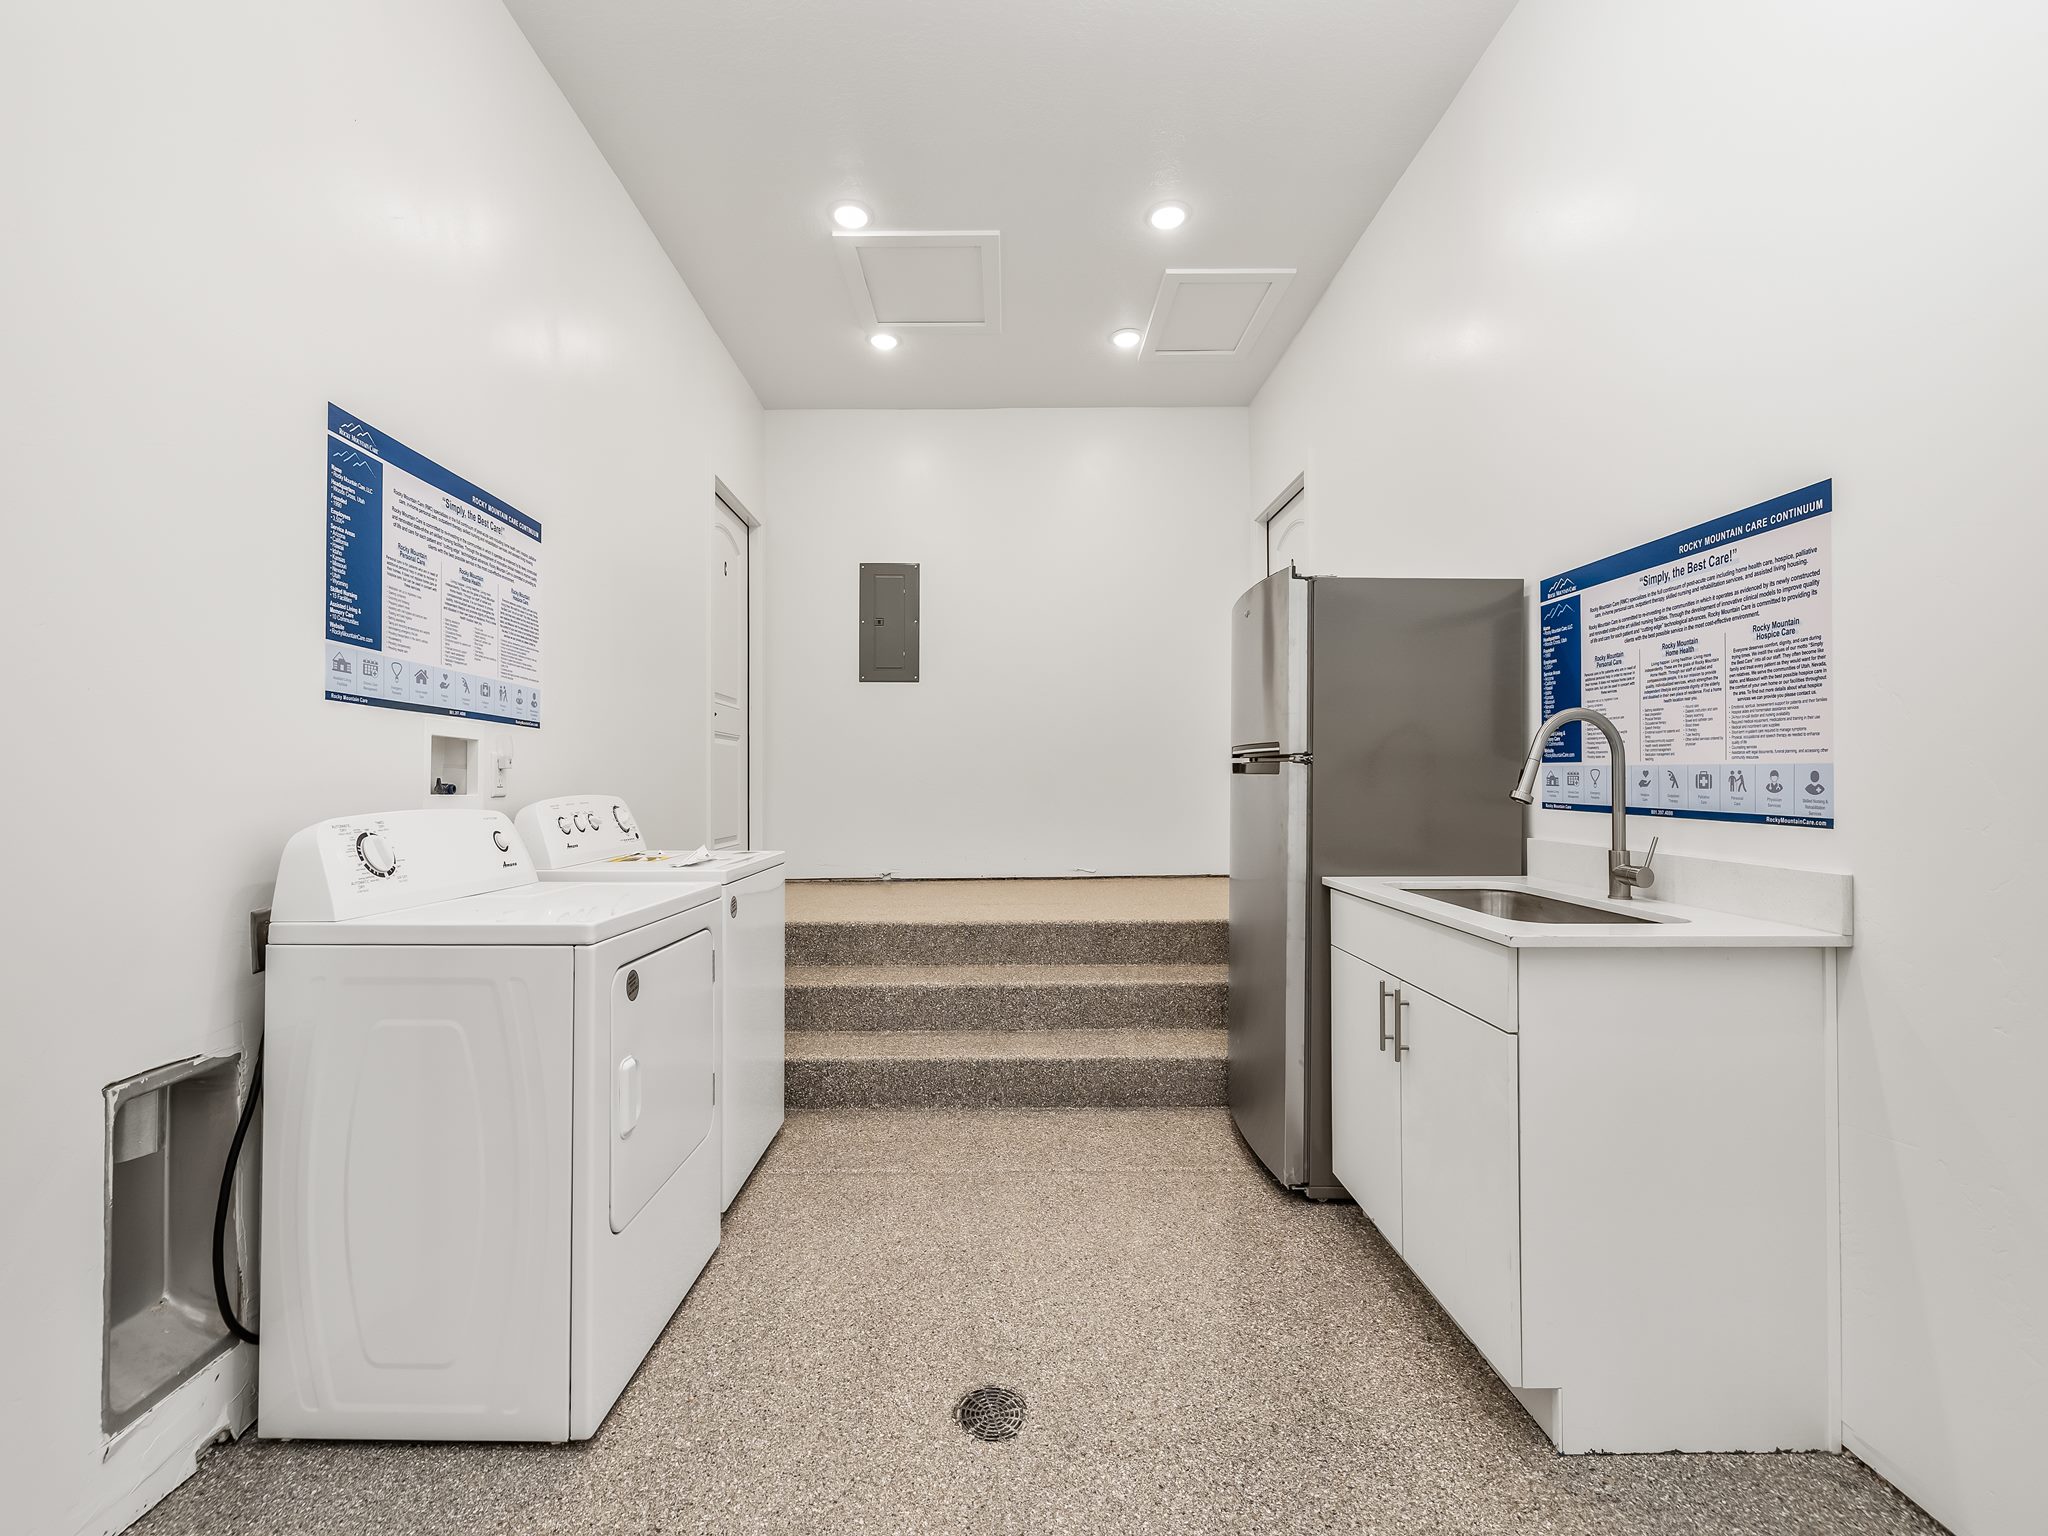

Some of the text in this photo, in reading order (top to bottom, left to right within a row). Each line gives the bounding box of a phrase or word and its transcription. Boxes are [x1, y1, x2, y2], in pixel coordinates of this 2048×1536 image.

[471, 495, 487, 510] ROCKY
[467, 509, 476, 522] the
[477, 514, 489, 528] Best
[1678, 498, 1823, 554] ROCKY MOUNTAIN CARE CONTINUUM
[1672, 565, 1685, 578] the
[1686, 557, 1706, 574] Best
[1708, 547, 1737, 568] Care!”
[1752, 616, 1799, 632] Rocky Mountain
[1756, 627, 1795, 640] Hospice Care
[1661, 636, 1698, 649] Rocky Mountain
[1679, 645, 1694, 654] Health
